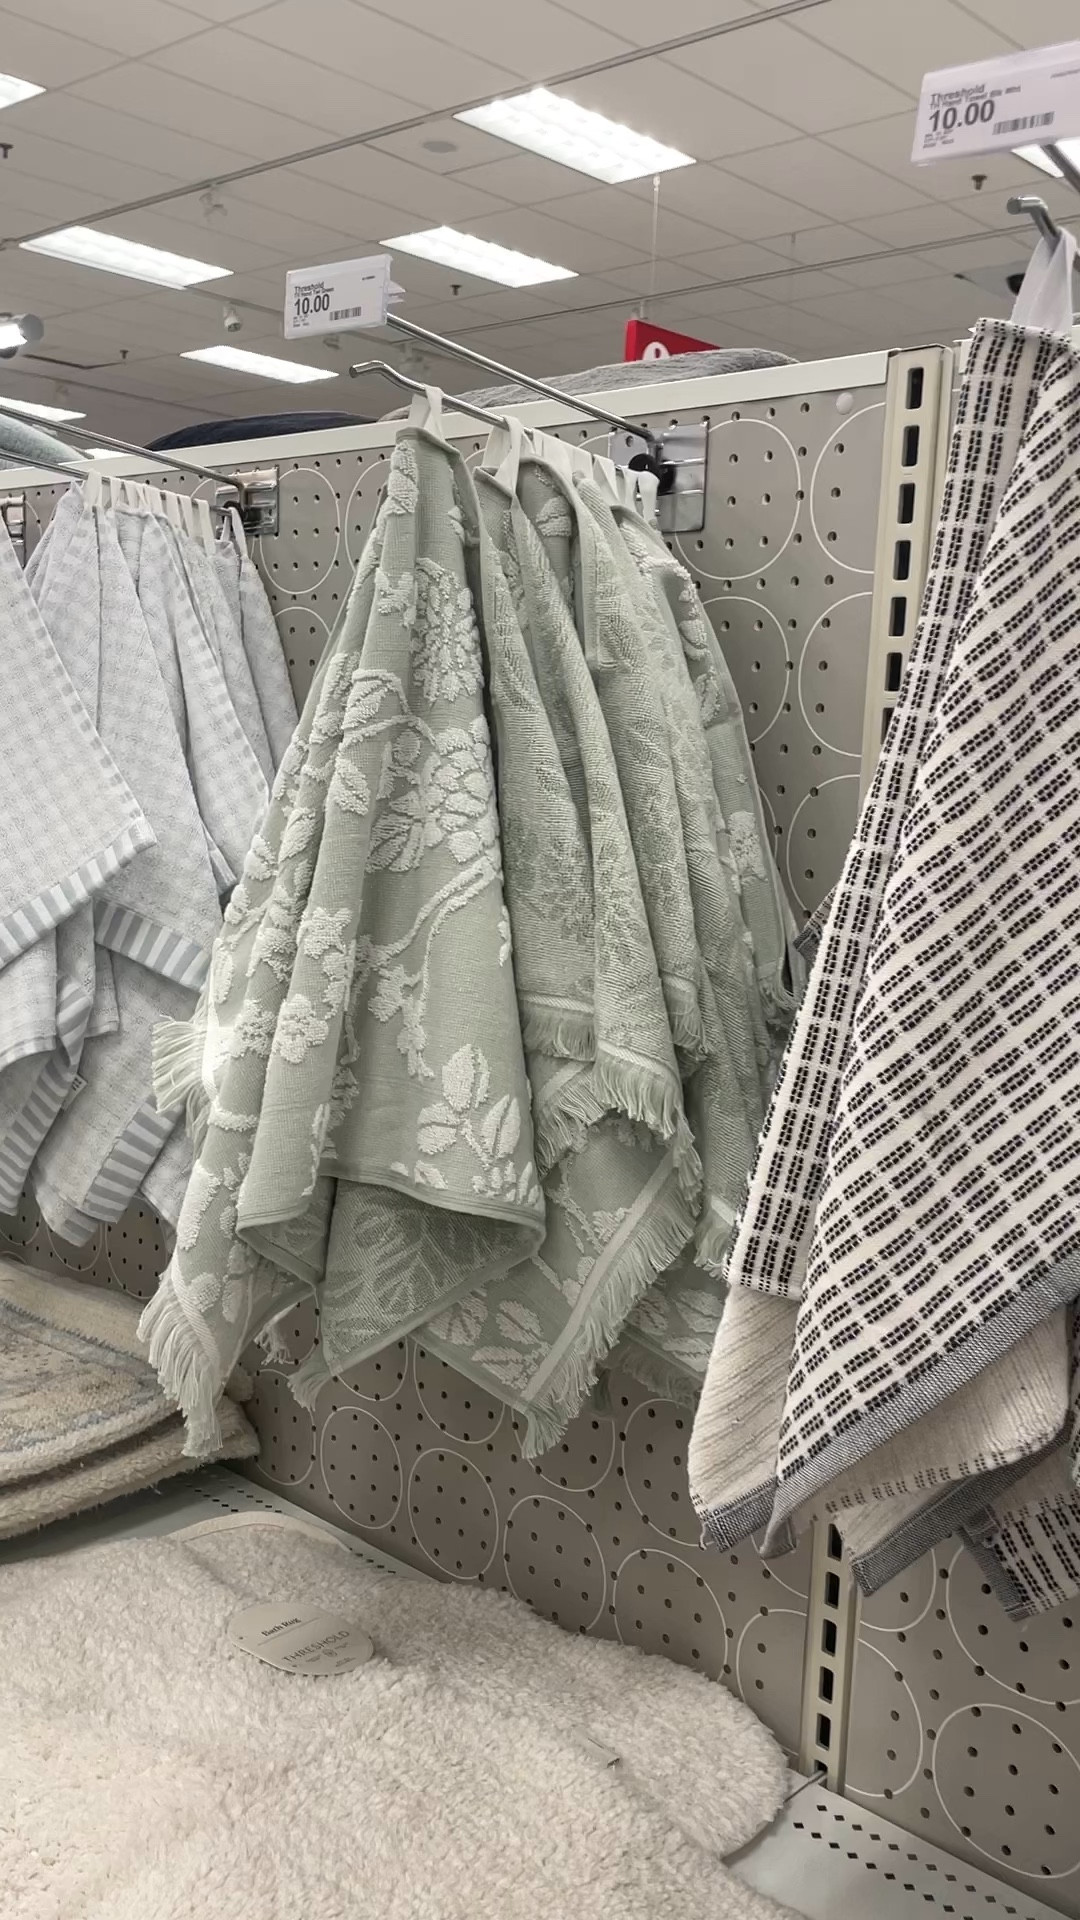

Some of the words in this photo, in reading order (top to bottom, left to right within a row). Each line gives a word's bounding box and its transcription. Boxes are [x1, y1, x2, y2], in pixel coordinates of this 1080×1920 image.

[931, 84, 985, 102] Threshold
[929, 100, 995, 132] 10.00
[294, 281, 325, 293] Threshold
[294, 293, 330, 316] 10.00
[261, 1624, 284, 1637] Bath
[281, 1617, 302, 1628] Rug
[283, 1630, 350, 1662] THRESHOLD
